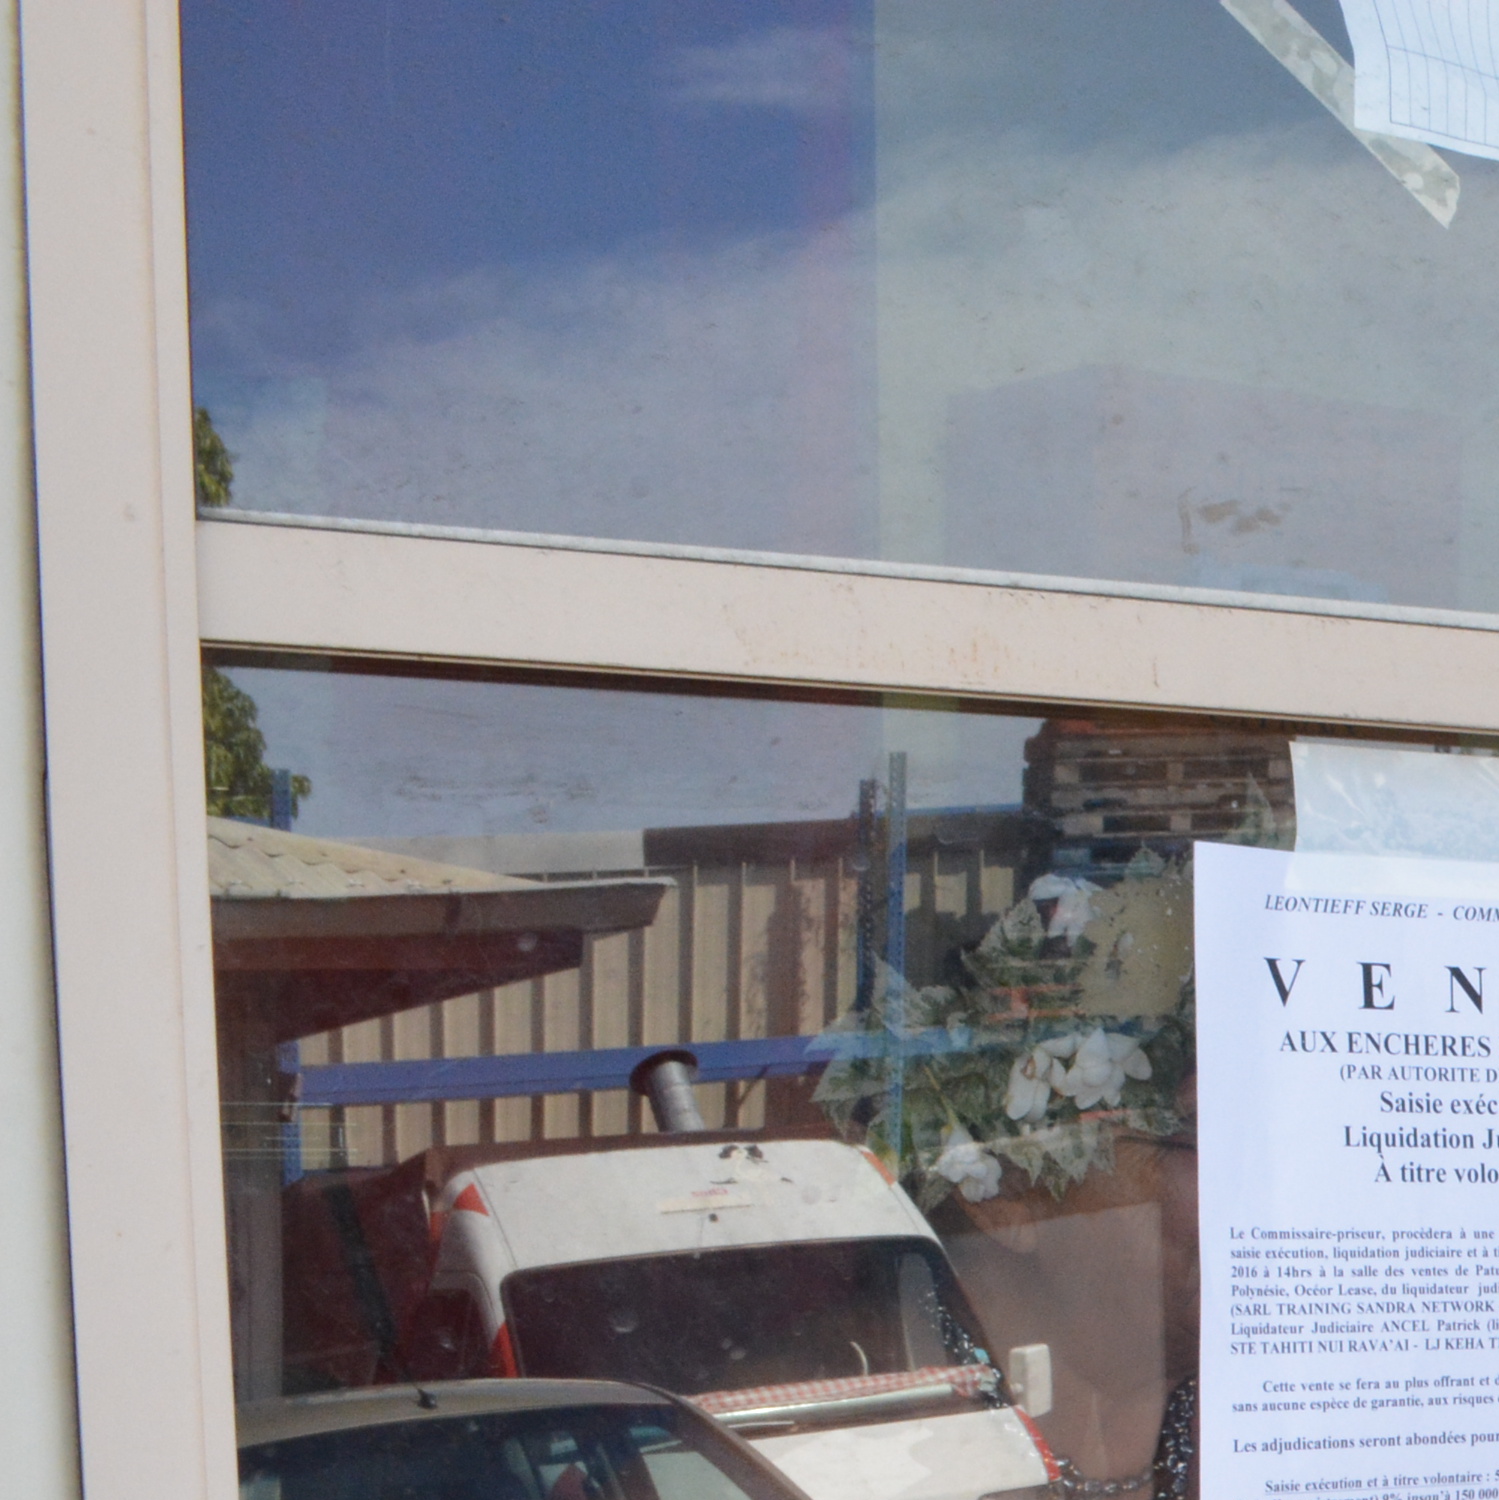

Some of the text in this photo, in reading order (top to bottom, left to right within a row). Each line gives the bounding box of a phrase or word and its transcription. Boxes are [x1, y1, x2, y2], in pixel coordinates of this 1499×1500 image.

[1264, 892, 1366, 916] LEONTIEFF
[1368, 900, 1428, 920] SERGE
[1280, 1030, 1338, 1053] AUX
[1347, 1031, 1491, 1058] ENCHERES
[1340, 1064, 1383, 1081] (PAR
[1388, 1065, 1480, 1083] AUTORITE
[1380, 1091, 1443, 1114] Saisie
[1344, 1125, 1474, 1155] Liquidation
[1376, 1154, 1391, 1183] À
[1400, 1161, 1447, 1183] titre
[1230, 1226, 1245, 1240] Le
[1473, 1230, 1495, 1240] une
[1230, 1246, 1262, 1259] saisie
[1332, 1246, 1400, 1262] liquidation
[1405, 1246, 1463, 1262] judiciaire
[1231, 1265, 1258, 1278] 2016
[1277, 1265, 1312, 1278] 14hrs
[1351, 1265, 1379, 1277] salle
[1384, 1265, 1405, 1277] des
[1411, 1266, 1449, 1277] ventes
[1402, 1283, 1469, 1298] liquidateur
[1276, 1302, 1352, 1316] TRAINING
[1356, 1301, 1416, 1314] SANDRA
[1422, 1300, 1495, 1313] NETWORK
[1231, 1322, 1305, 1339] Liquidateur
[1311, 1320, 1374, 1334] Judiciaire
[1381, 1319, 1430, 1333] ANCEL
[1437, 1319, 1481, 1332] Patrick
[1230, 1341, 1256, 1355] STE
[1260, 1340, 1313, 1355] TAHITI
[1318, 1340, 1344, 1353] NUI
[1425, 1338, 1440, 1351] LJ
[1262, 1380, 1296, 1393] Cette
[1300, 1381, 1335, 1392] vente
[1356, 1378, 1380, 1390] fera
[1404, 1376, 1429, 1392] plus
[1433, 1375, 1475, 1388] offrant
[1232, 1403, 1258, 1412] sans
[1262, 1401, 1306, 1412] aucune
[1427, 1397, 1449, 1406] aux
[1452, 1393, 1494, 1408] risques
[1233, 1439, 1257, 1453] Les
[1261, 1435, 1355, 1455] adjudications
[1359, 1435, 1401, 1448] seront
[1265, 1479, 1301, 1495] Saisie
[1393, 1474, 1420, 1487] titre
[1423, 1471, 1483, 1485] volontaire
[1478, 1487, 1499, 1500] 000
